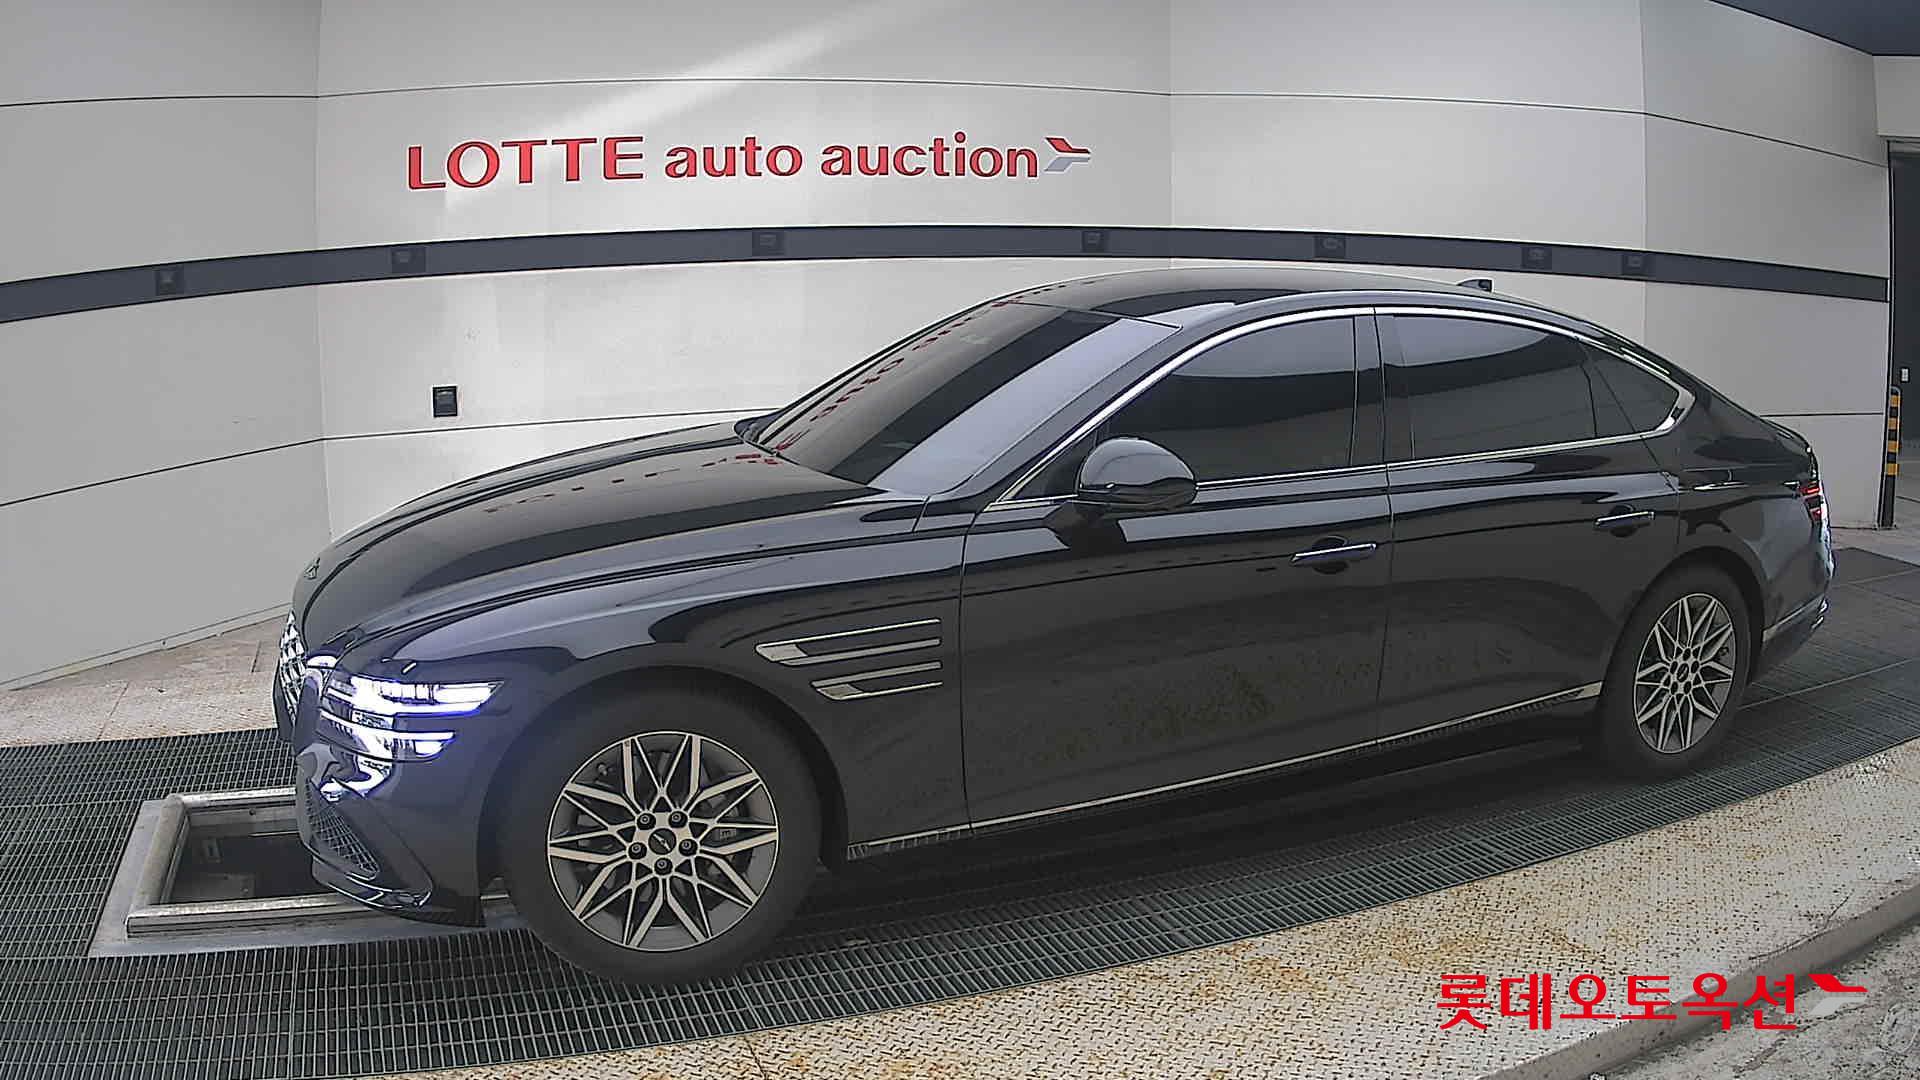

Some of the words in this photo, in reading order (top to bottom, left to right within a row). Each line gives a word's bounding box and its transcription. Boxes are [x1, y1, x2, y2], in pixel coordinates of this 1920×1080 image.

[407, 136, 644, 189] LOTTE
[664, 136, 803, 179] auto
[820, 132, 1039, 178] auction
